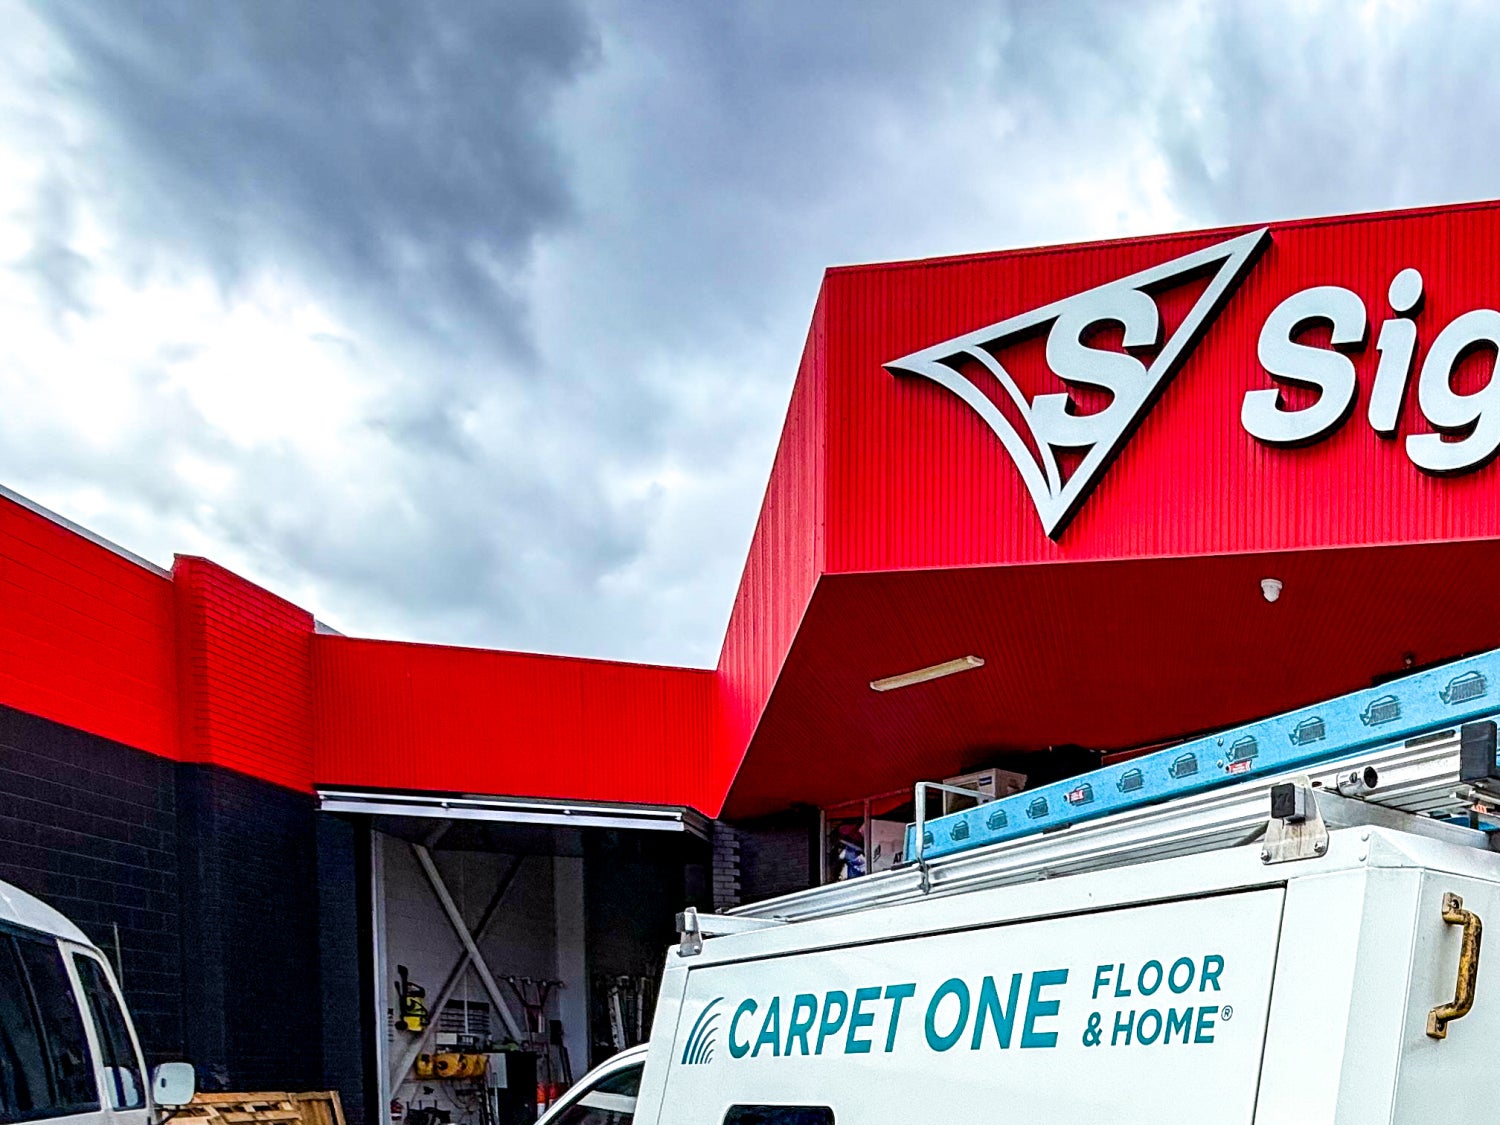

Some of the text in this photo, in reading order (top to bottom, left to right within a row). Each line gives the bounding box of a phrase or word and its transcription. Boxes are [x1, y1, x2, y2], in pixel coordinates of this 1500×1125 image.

[1092, 954, 1225, 999] FLOOR
[728, 968, 1069, 1059] CARPET ONE
[1082, 1014, 1103, 1048] &
